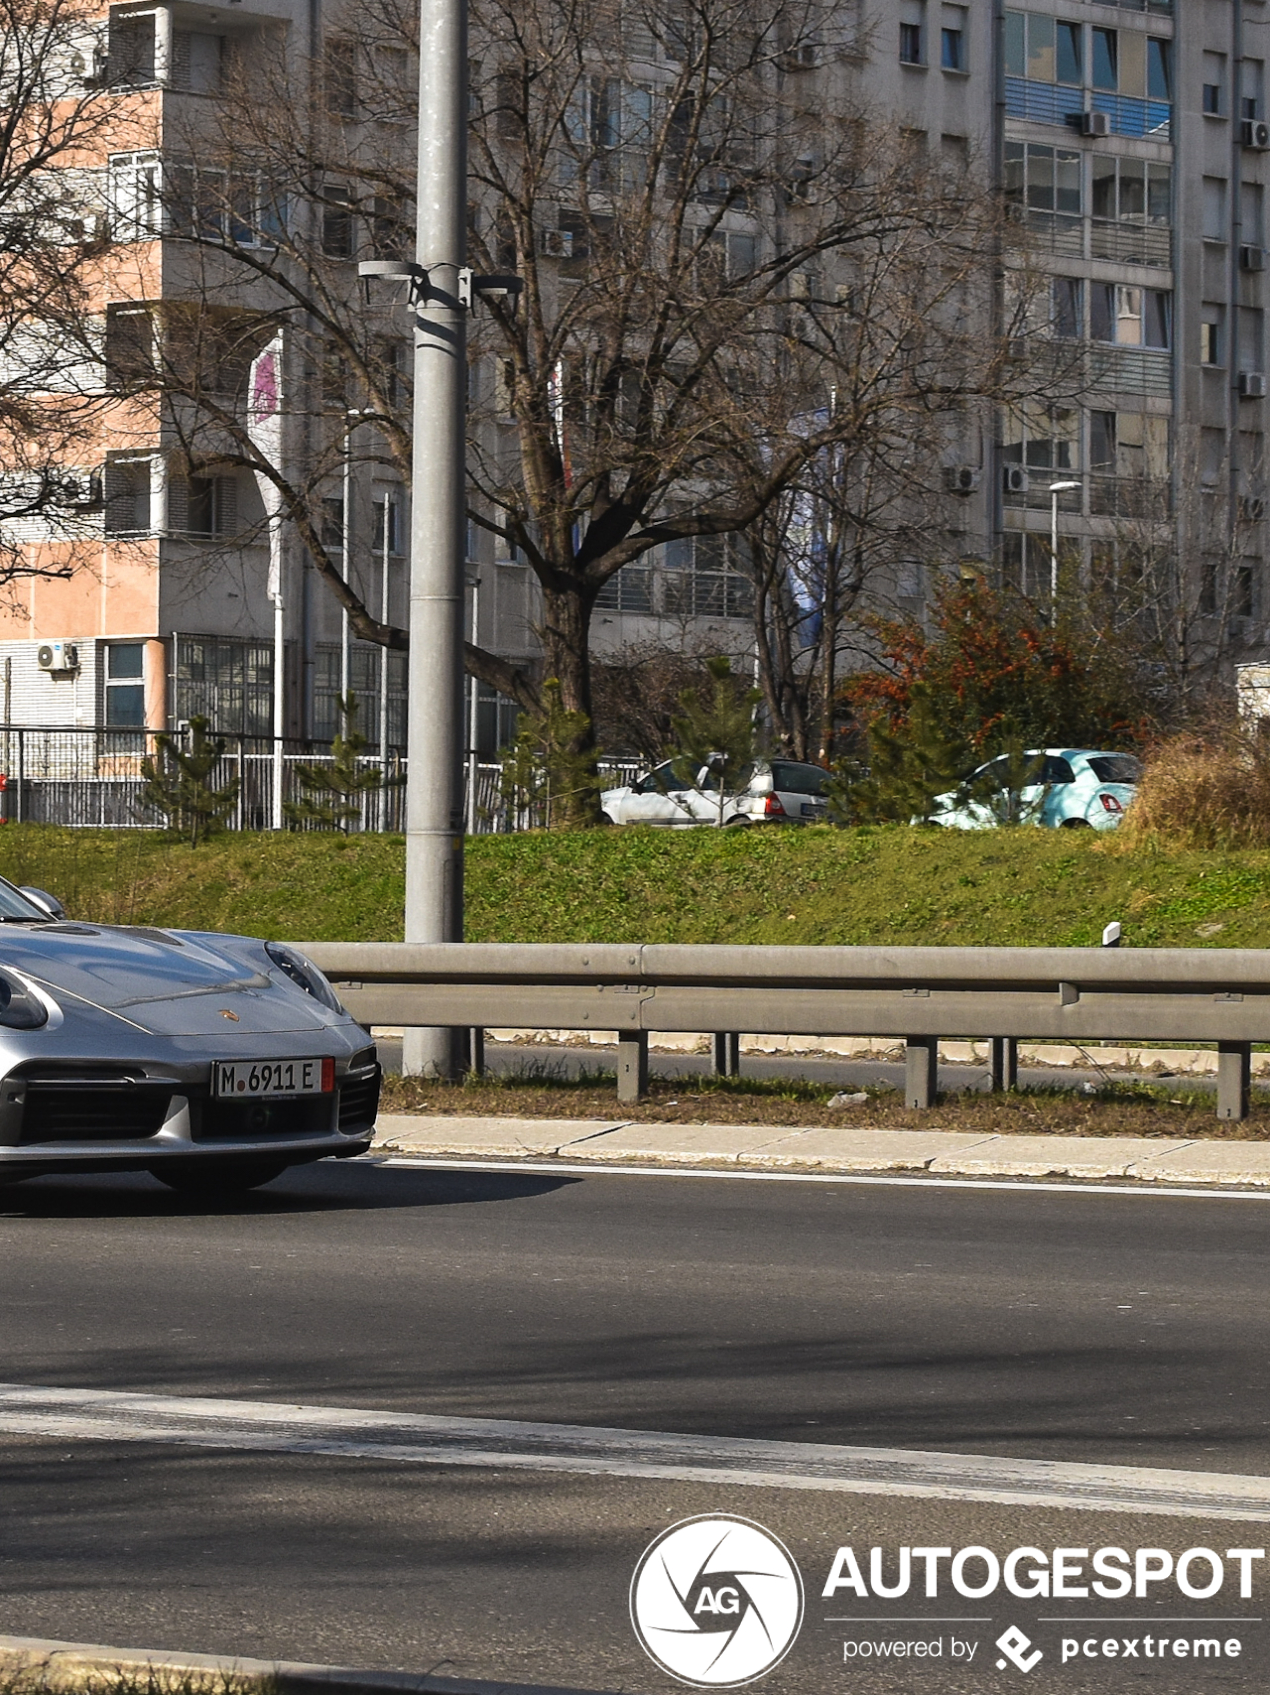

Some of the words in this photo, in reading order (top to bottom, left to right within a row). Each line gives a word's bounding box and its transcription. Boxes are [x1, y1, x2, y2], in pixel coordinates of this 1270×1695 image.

[221, 1067, 235, 1093] M
[248, 1064, 296, 1092] 6911
[303, 1063, 314, 1089] E
